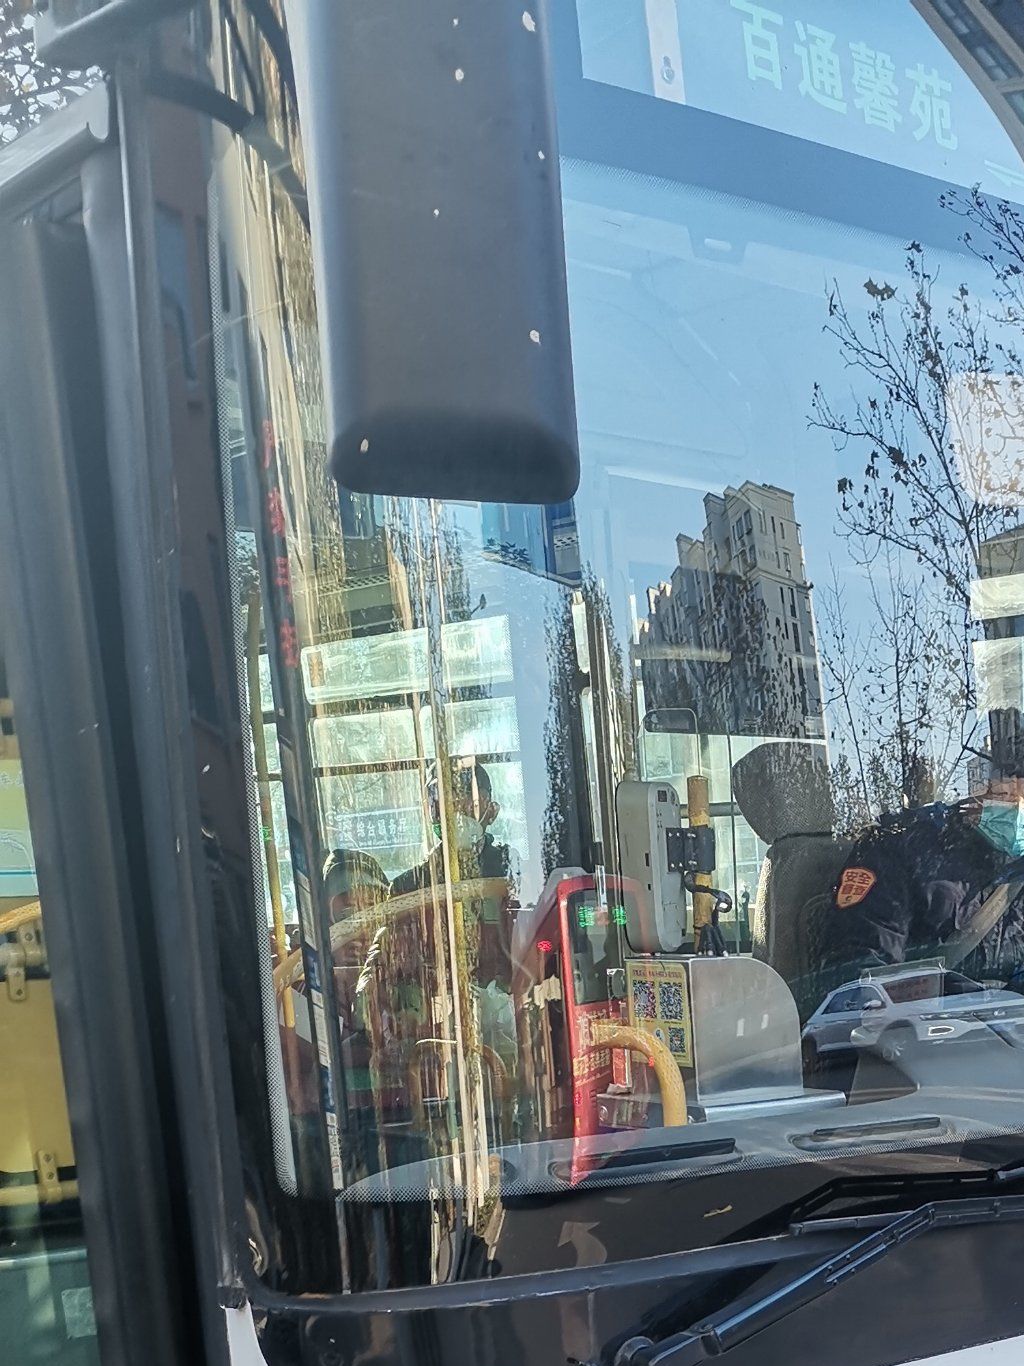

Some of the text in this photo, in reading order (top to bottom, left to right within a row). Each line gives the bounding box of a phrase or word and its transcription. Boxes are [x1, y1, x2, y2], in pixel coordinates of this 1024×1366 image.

[730, 0, 958, 150] 百通馨苑
[844, 870, 872, 886] 安全
